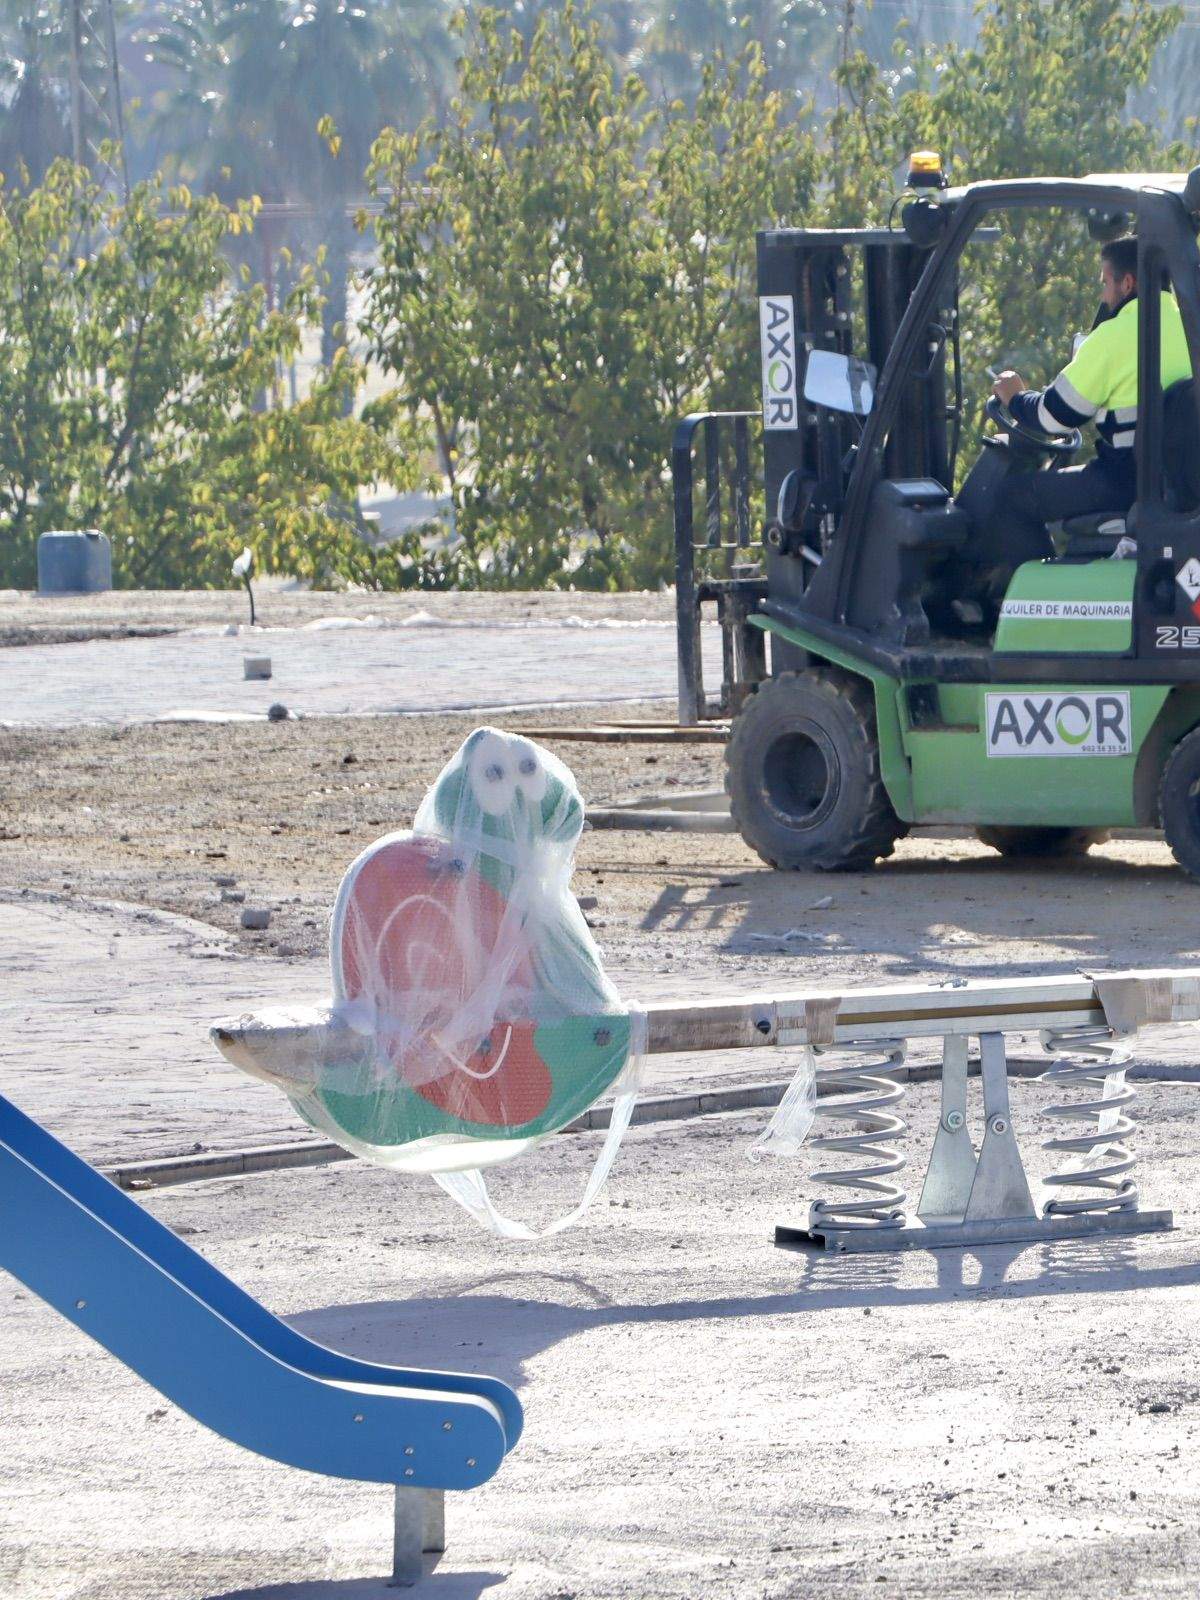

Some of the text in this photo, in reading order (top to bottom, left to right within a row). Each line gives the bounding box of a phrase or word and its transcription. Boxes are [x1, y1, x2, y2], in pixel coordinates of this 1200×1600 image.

[766, 301, 793, 424] AXOR
[1045, 604, 1060, 615] DE
[1063, 604, 1131, 616] MAQUINARIA
[991, 696, 1127, 745] AXOR
